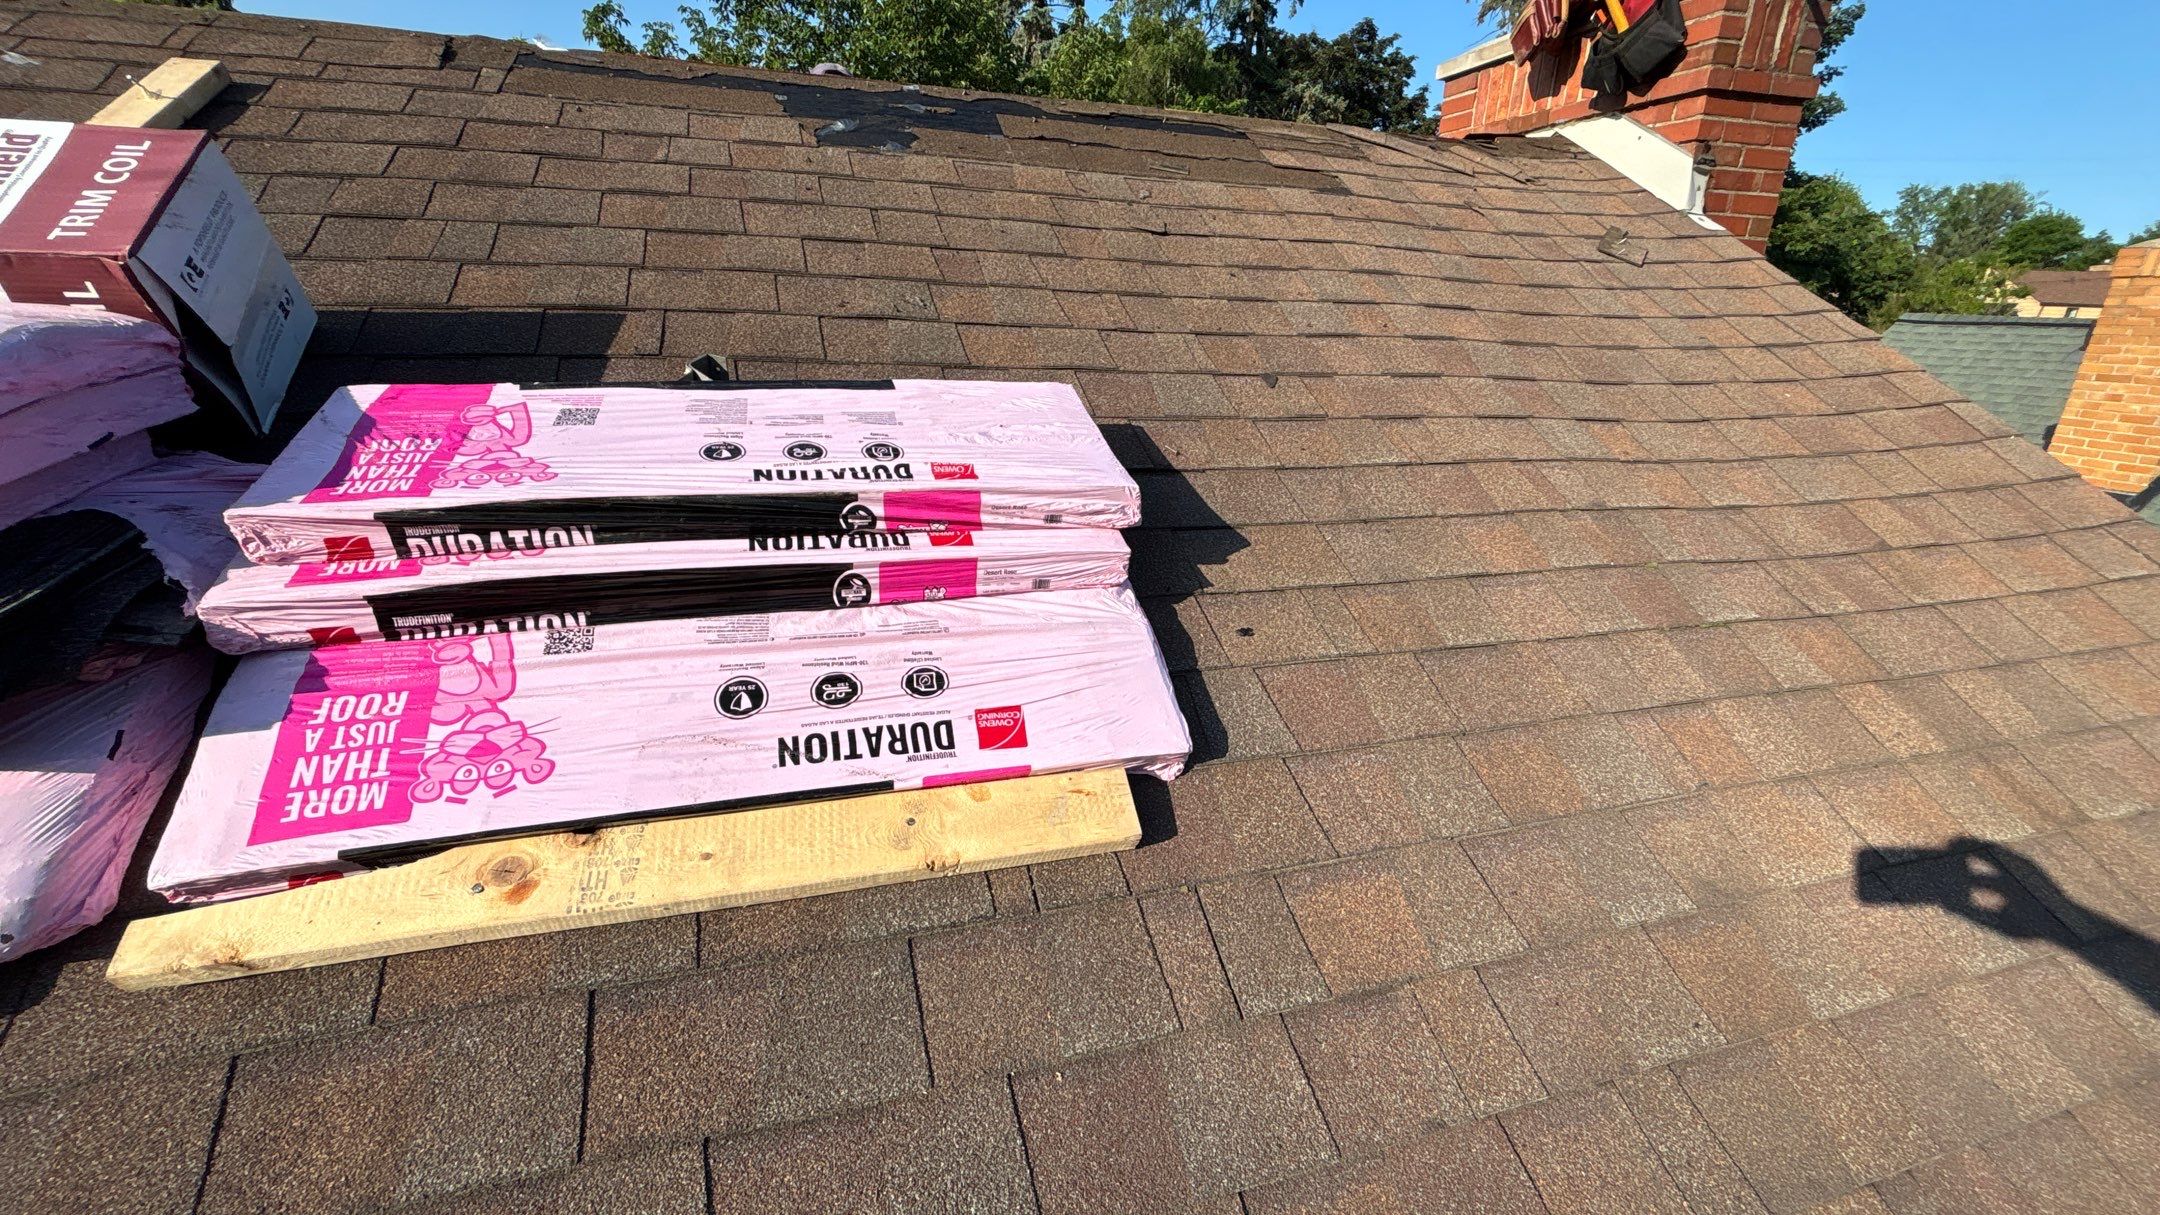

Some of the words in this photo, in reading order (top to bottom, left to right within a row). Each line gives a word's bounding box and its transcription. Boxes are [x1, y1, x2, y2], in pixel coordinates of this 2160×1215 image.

[47, 190, 118, 240] TRIM
[93, 140, 152, 184] COIL
[359, 453, 376, 465] A
[376, 451, 434, 464] JUST
[343, 464, 422, 480] THAN
[754, 463, 914, 482] DURATION
[392, 614, 453, 627] TRUDEFINITION
[307, 690, 410, 724] ROOF
[977, 710, 1020, 720] CORNING
[978, 719, 1014, 728] OWENS
[305, 727, 325, 749] A
[329, 719, 396, 750] JUST
[778, 720, 956, 768] DURATION
[906, 751, 957, 763] TRUDEFINITION
[289, 747, 391, 788] THAN
[280, 781, 389, 823] MORE
